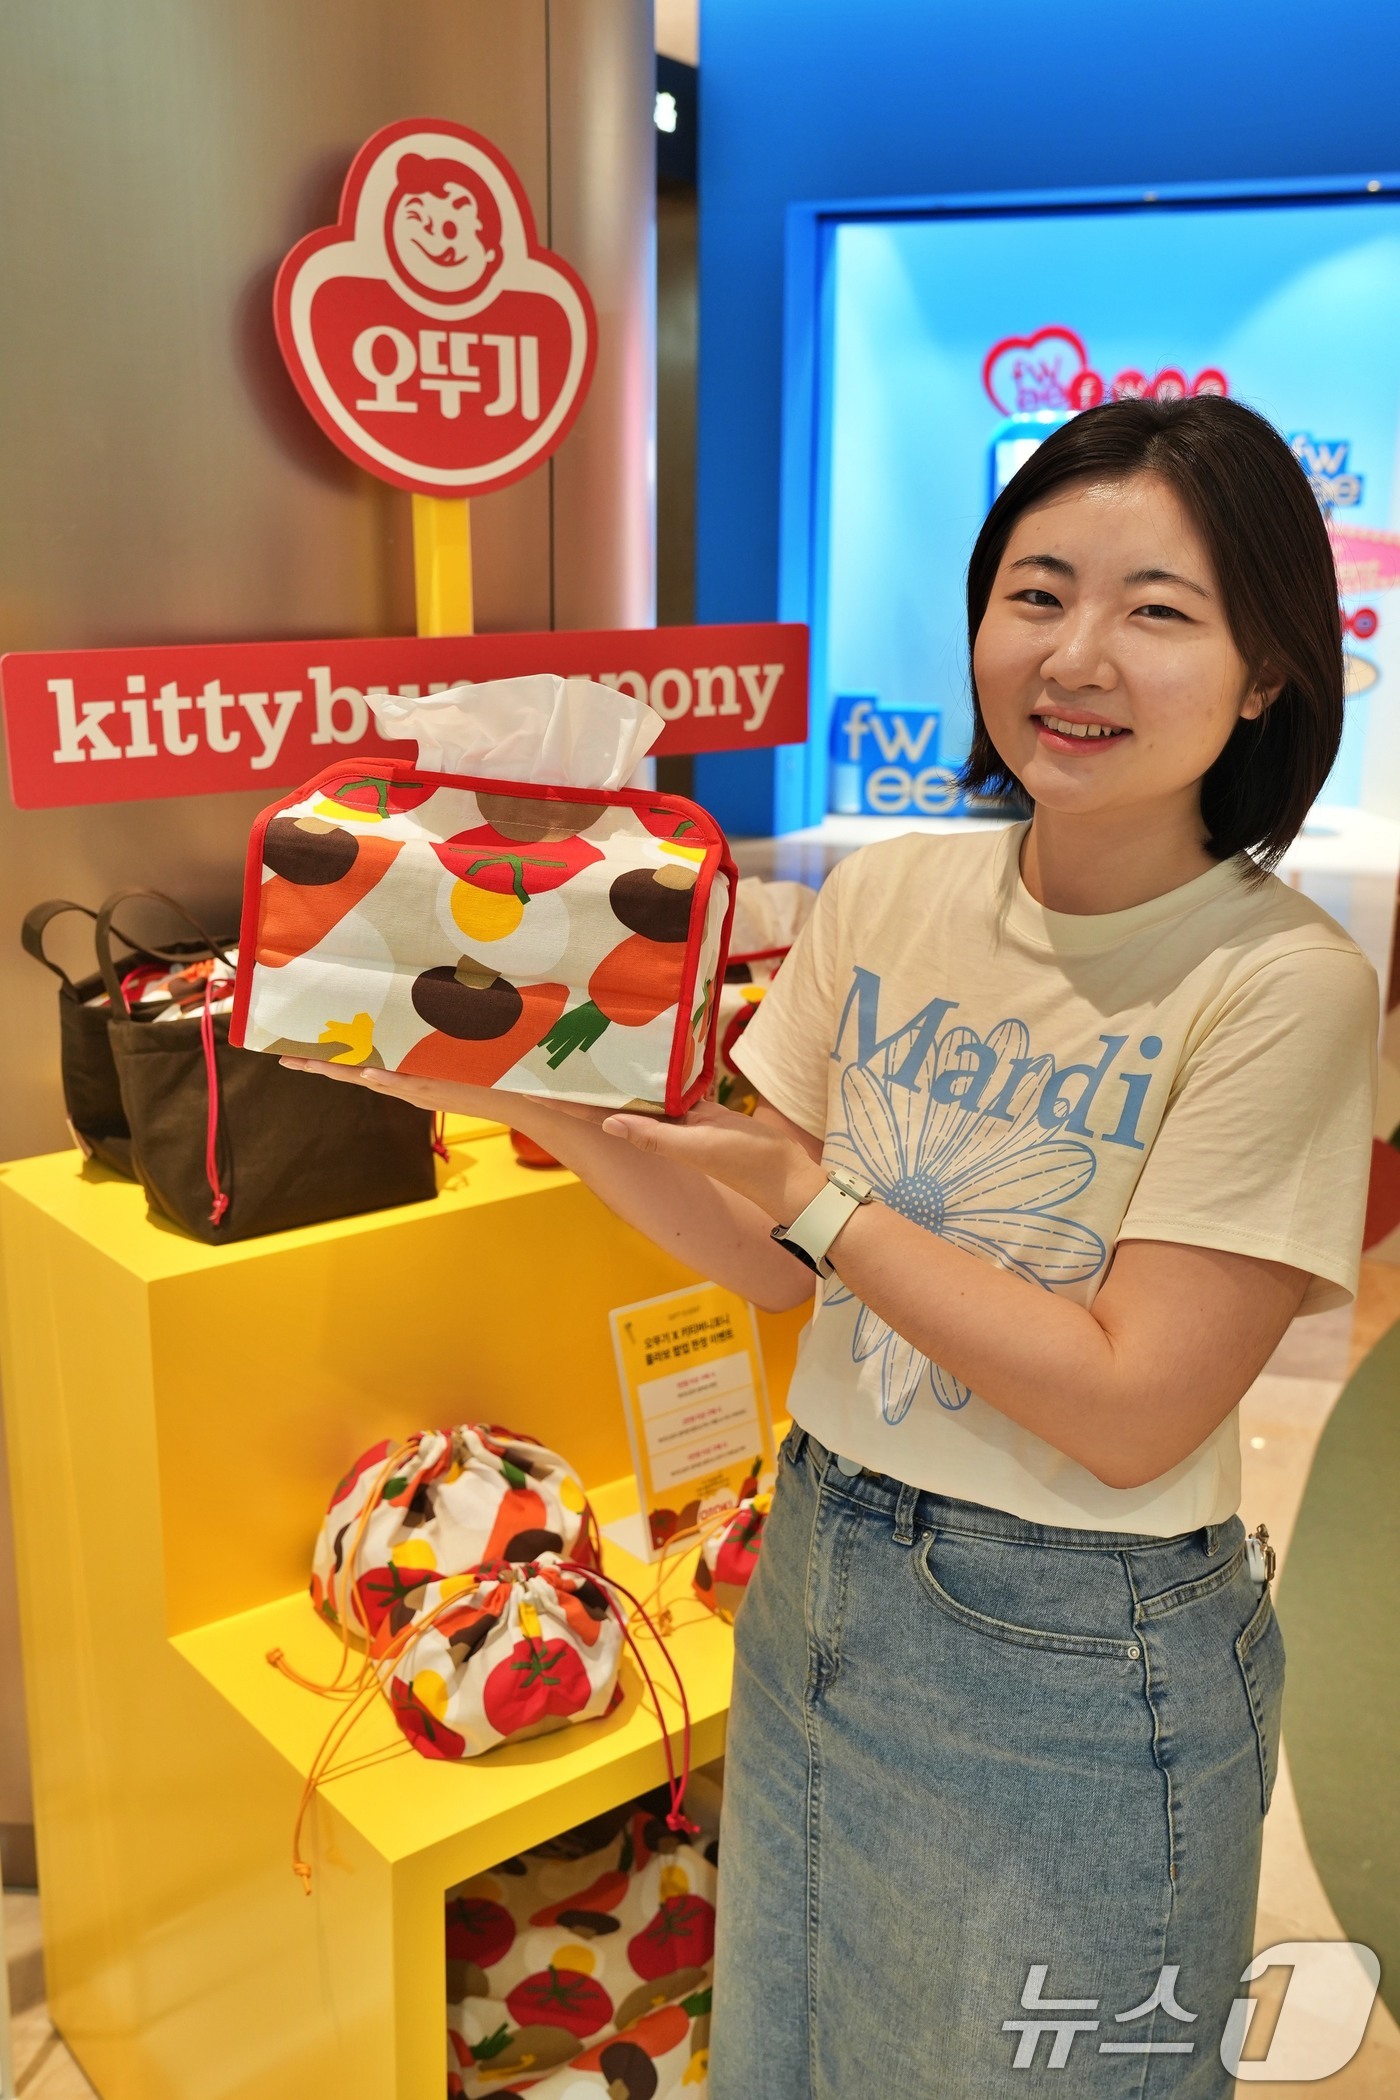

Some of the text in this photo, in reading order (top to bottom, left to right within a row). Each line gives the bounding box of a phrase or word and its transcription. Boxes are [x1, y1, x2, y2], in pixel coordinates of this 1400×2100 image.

[352, 325, 541, 421] 오뚜기
[842, 700, 938, 763] fw
[829, 964, 1164, 1151] Mardi
